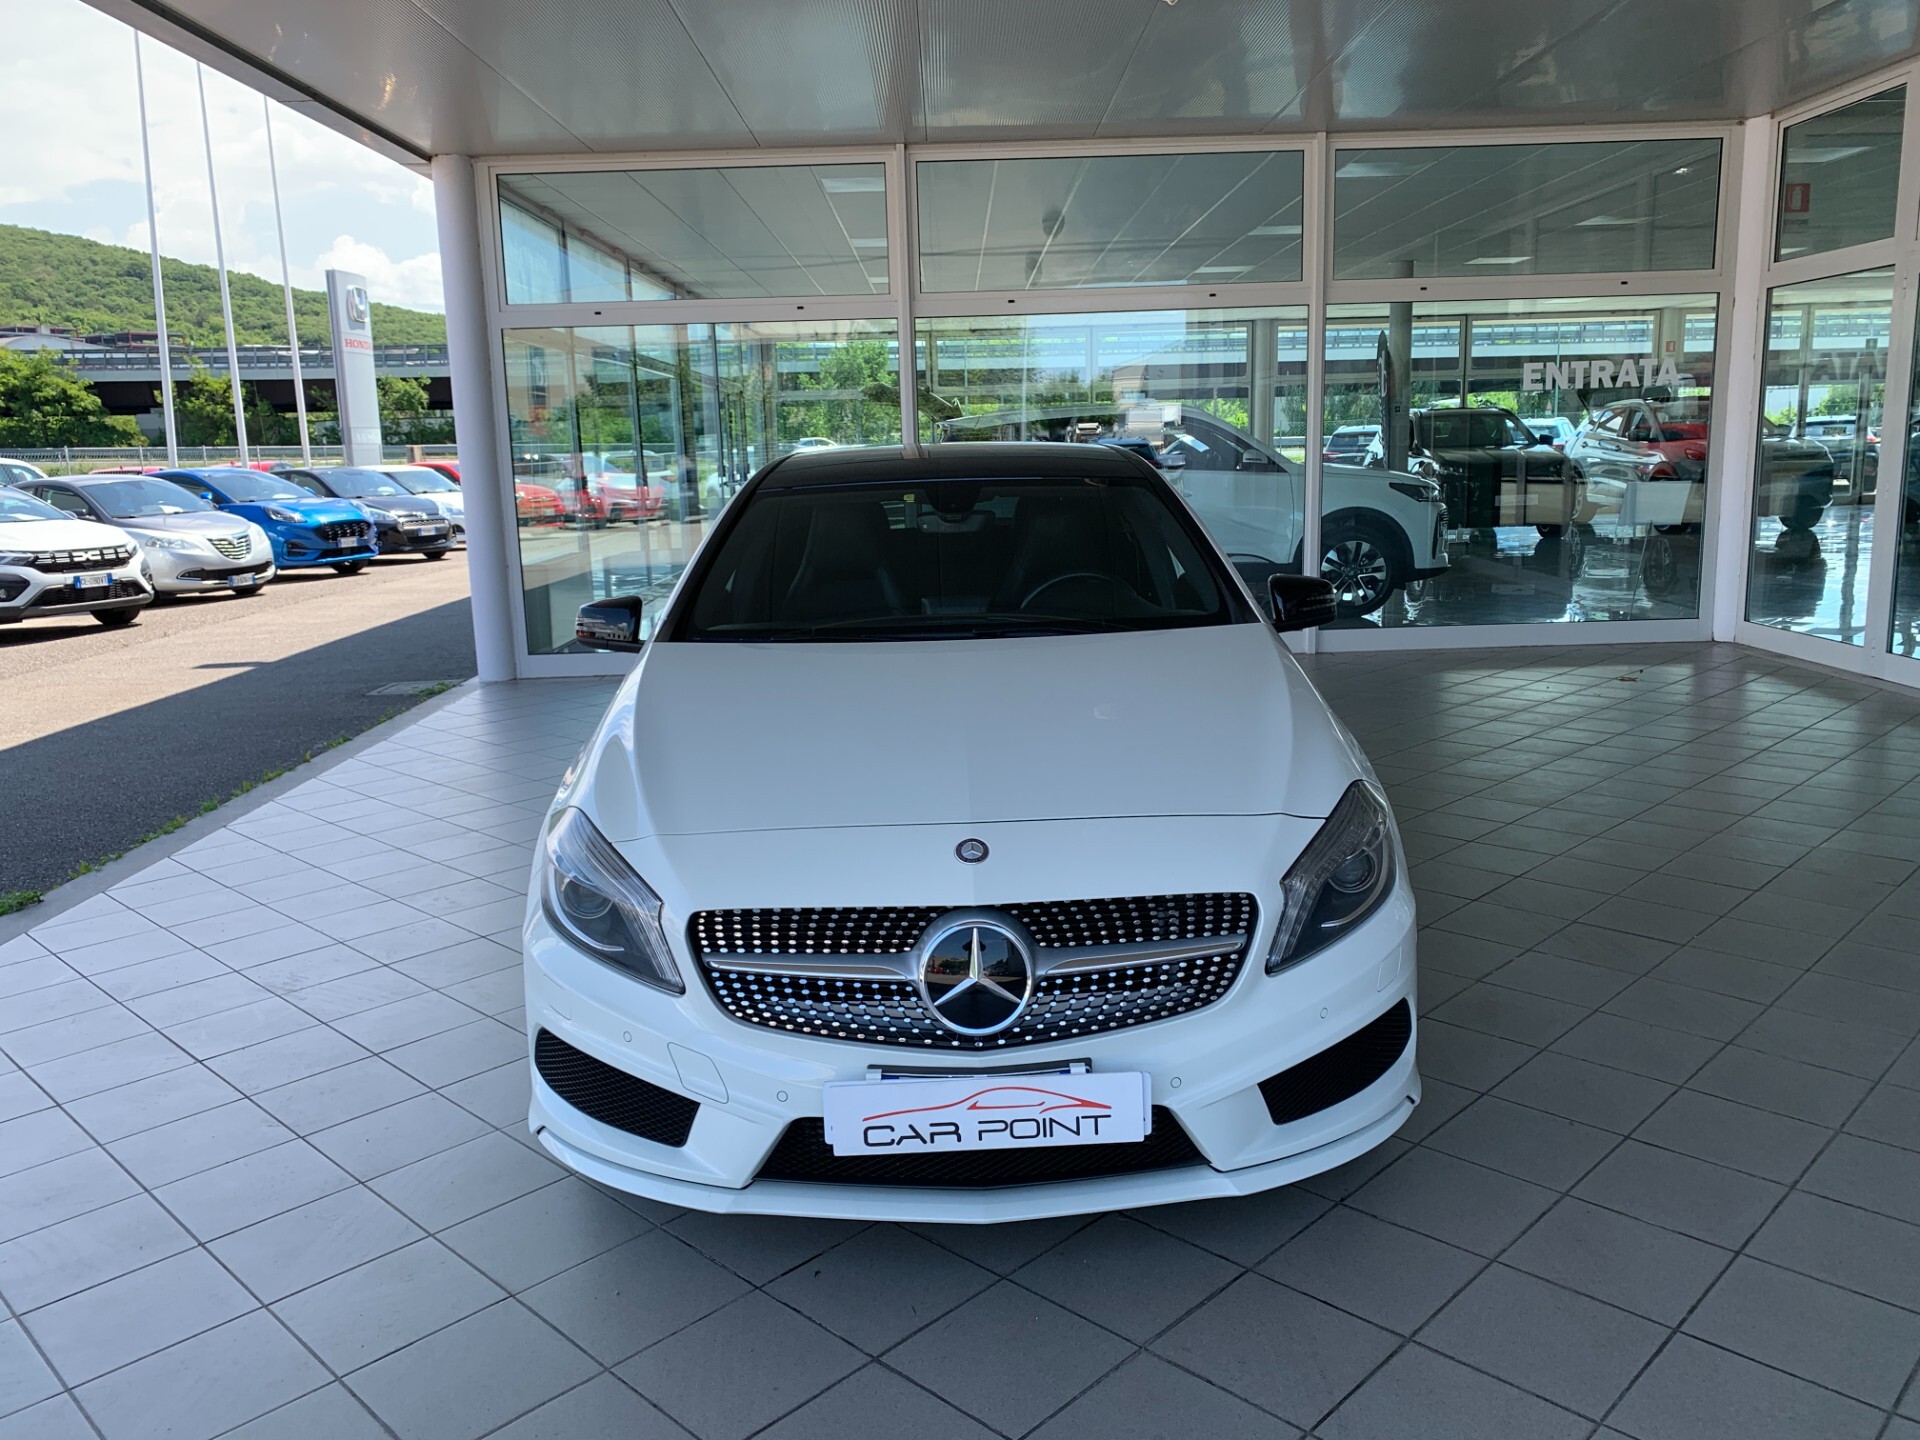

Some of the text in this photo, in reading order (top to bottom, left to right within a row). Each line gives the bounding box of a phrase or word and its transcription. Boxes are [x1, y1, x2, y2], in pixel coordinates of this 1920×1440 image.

[1523, 358, 1678, 390] ENTRATA
[863, 1114, 1112, 1147] CAR POINT
